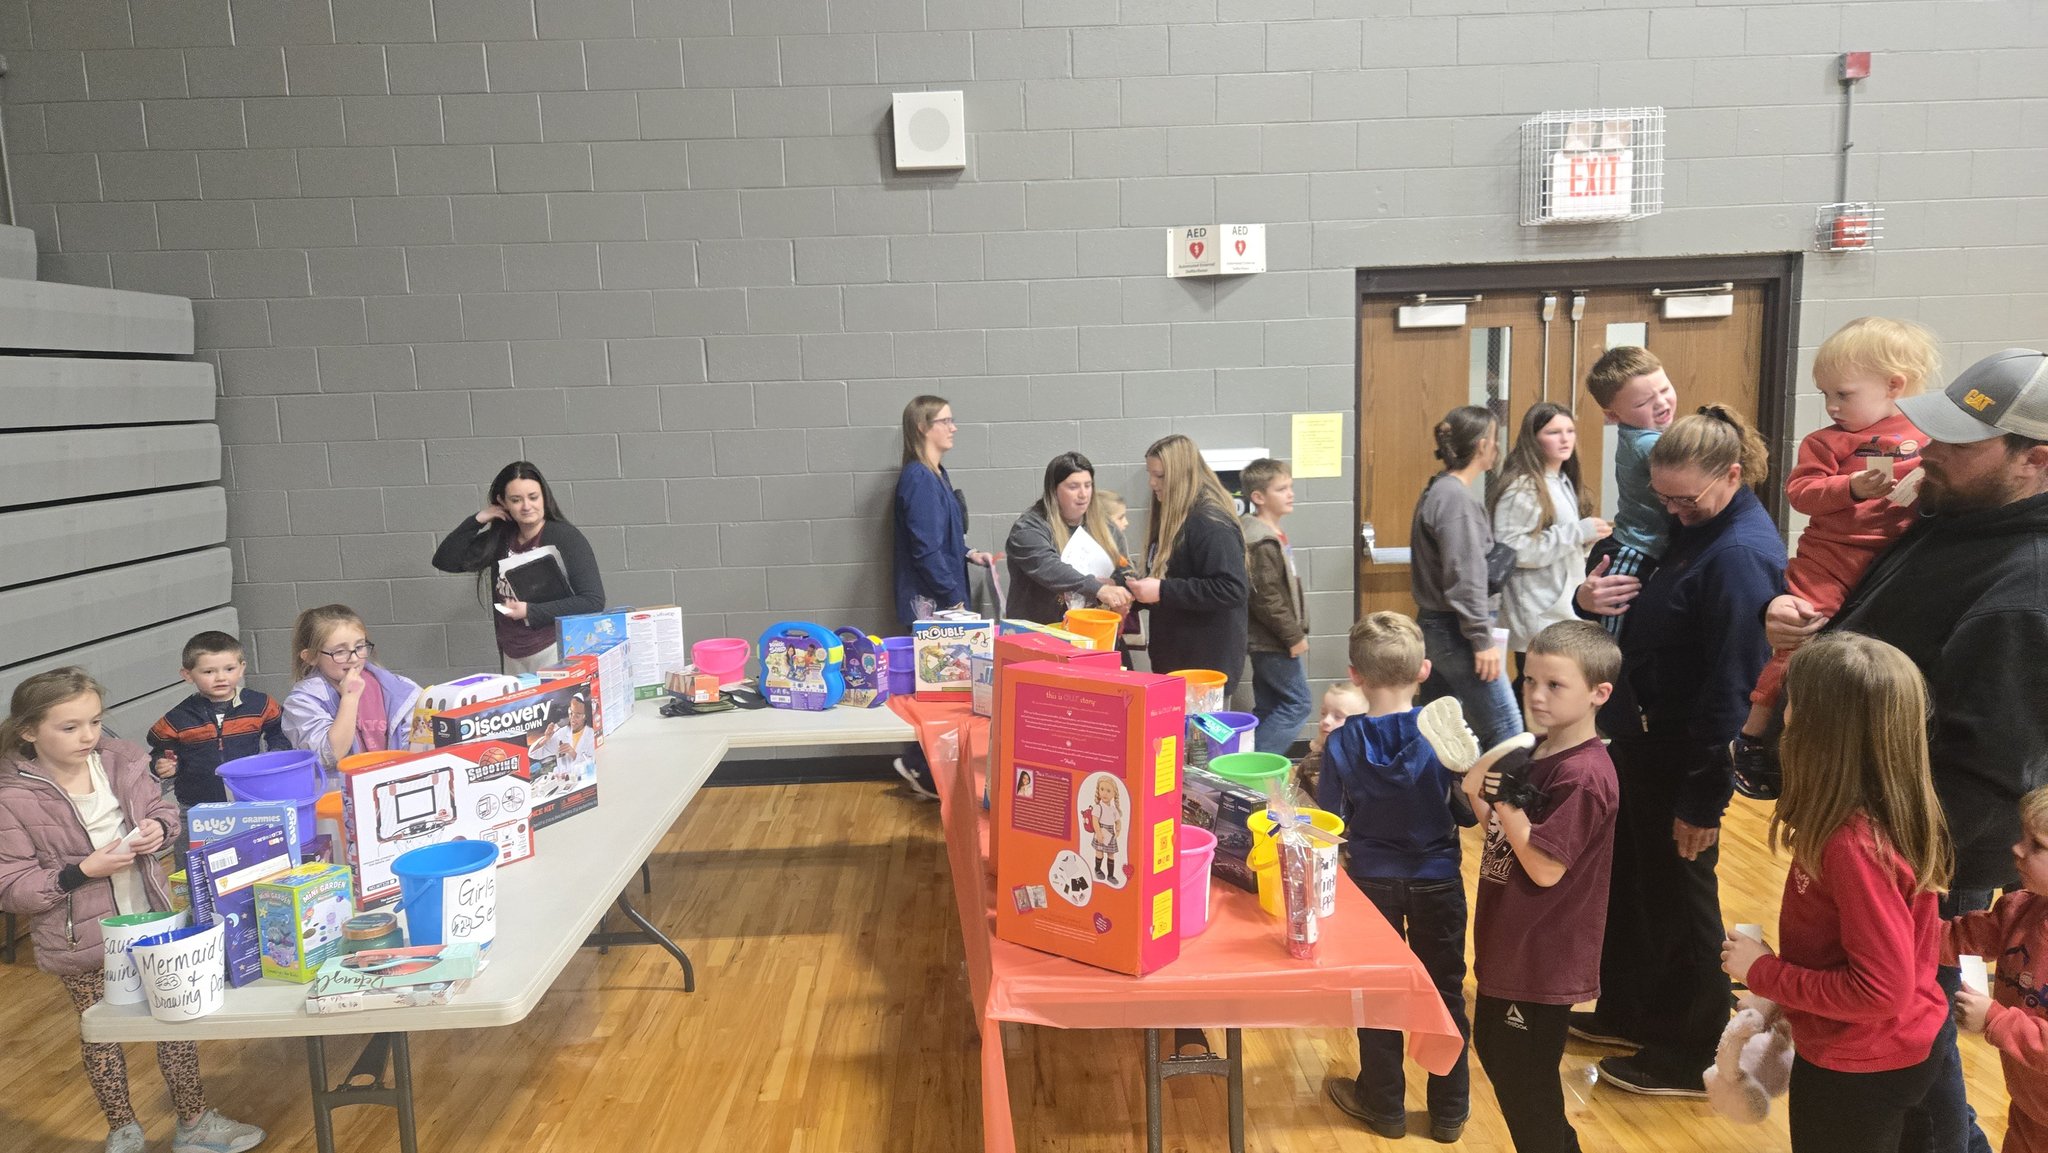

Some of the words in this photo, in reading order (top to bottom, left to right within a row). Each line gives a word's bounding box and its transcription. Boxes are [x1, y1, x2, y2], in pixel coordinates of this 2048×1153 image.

[1569, 156, 1621, 197] EXIT
[1186, 227, 1208, 239] AED
[1231, 225, 1249, 236] AED
[1963, 388, 1997, 412] CAT
[916, 625, 966, 641] TROUBLE
[460, 699, 552, 740] Discovery
[467, 756, 518, 781] SHOOTING
[320, 880, 347, 894] GARDEN
[458, 878, 494, 906] Girls
[142, 936, 218, 976] Mermaid
[152, 989, 203, 1016] Drawing
